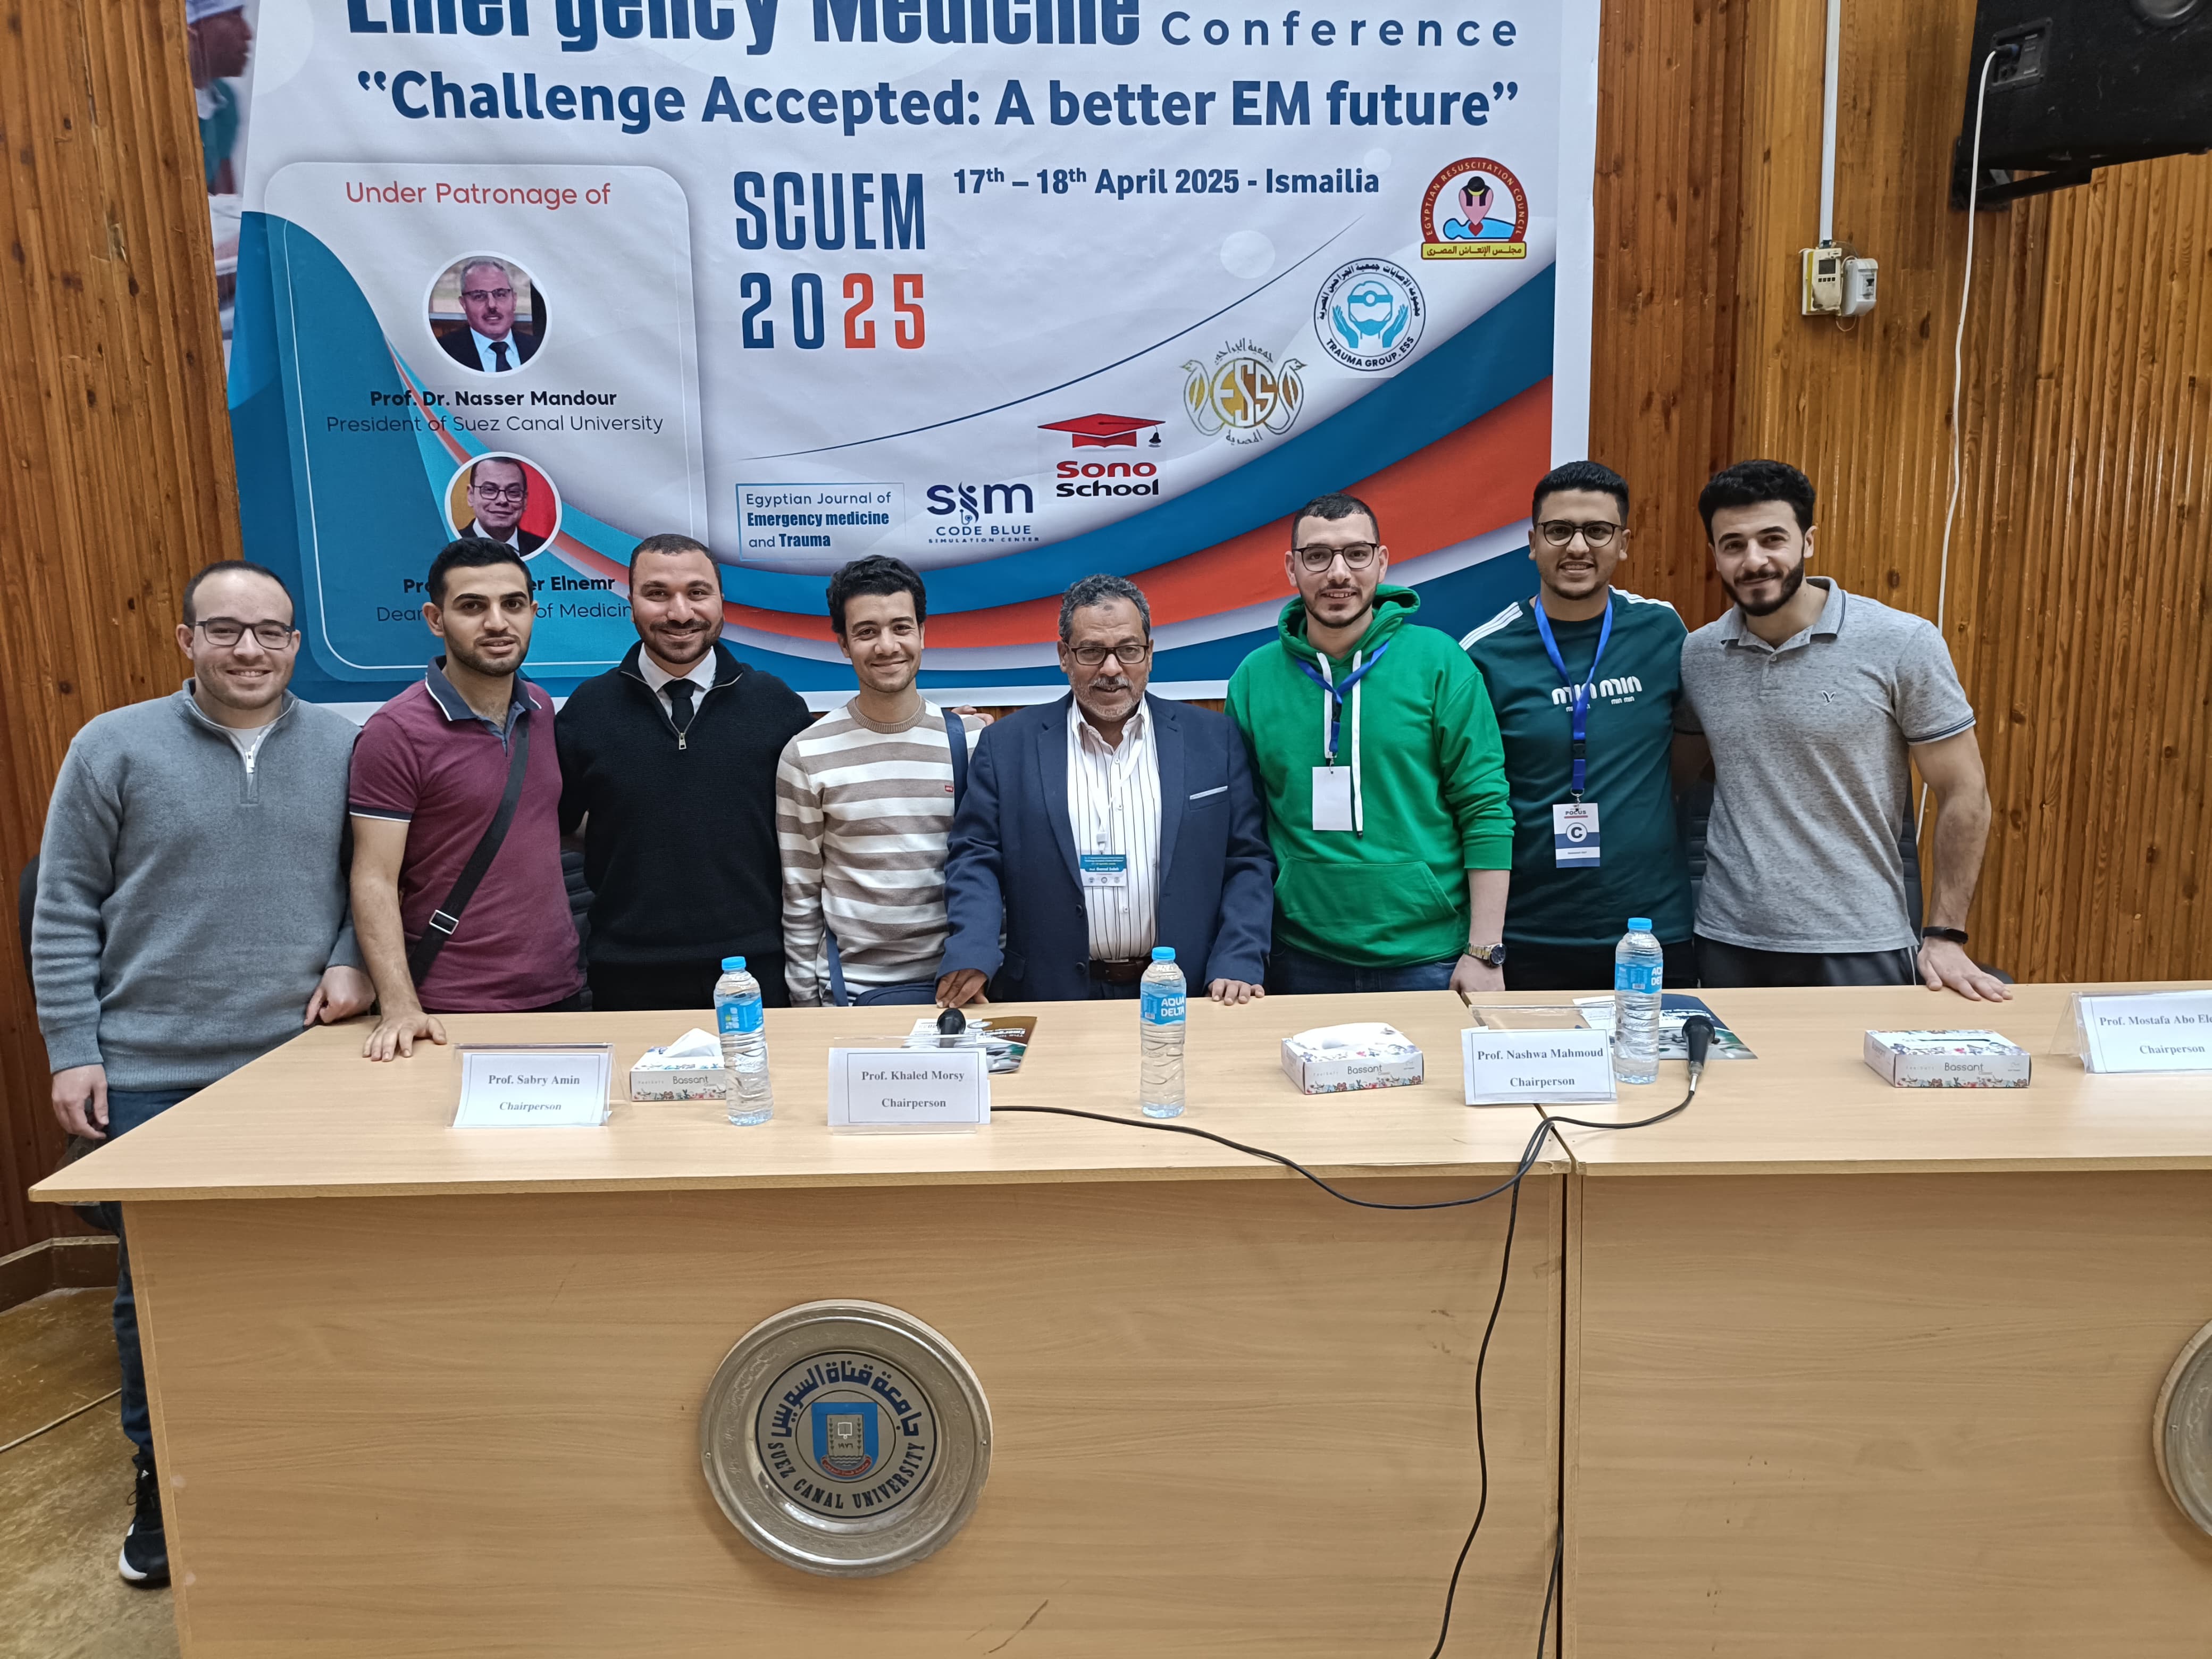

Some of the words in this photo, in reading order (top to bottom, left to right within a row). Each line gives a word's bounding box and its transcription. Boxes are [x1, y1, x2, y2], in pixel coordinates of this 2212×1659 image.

[1161, 11, 1517, 46] Conference
[701, 76, 980, 136] Accepted:
[994, 80, 1035, 125] A
[1049, 80, 1216, 125] better
[1233, 81, 1310, 125] EM
[953, 167, 1004, 194] 17th
[1036, 167, 1086, 194] 18th
[1095, 168, 1168, 200] April
[1175, 169, 1239, 194] 2025
[1266, 169, 1379, 194] Ismailia
[346, 181, 426, 203] Under
[435, 182, 577, 210] Patronage
[585, 182, 611, 205] of
[1424, 182, 1440, 236] EGYPTIAN
[1440, 162, 1514, 186] RESUSCITATION
[1513, 188, 1525, 234] COUNCIL
[734, 171, 926, 250] SCUEM
[1493, 246, 1522, 255] مجلس
[740, 272, 925, 349] 2025
[1326, 338, 1362, 366] TRAUMA
[1399, 337, 1414, 354] ESS
[370, 391, 417, 406] Prof.
[423, 391, 450, 406] Dr.
[455, 391, 524, 406] Nasser
[531, 391, 617, 406] Mandour
[326, 416, 422, 432] President
[428, 416, 447, 431] of
[453, 416, 500, 431] Suez
[506, 416, 564, 431] Canal
[571, 416, 664, 434] University
[1056, 460, 1157, 478] Sono
[1056, 479, 1159, 497] School
[746, 493, 812, 508] Egyptian
[817, 492, 872, 505] Journal
[877, 491, 891, 503] of
[747, 512, 823, 527] Emergency
[826, 511, 889, 525] medicine
[936, 526, 982, 535] CODE
[991, 525, 1032, 535] BLUE
[749, 535, 775, 548] and
[778, 533, 831, 547] Trauma
[551, 575, 615, 591] Elnemr
[536, 602, 554, 618] of
[560, 602, 632, 618] Medicin
[1571, 826, 1582, 839] C
[1651, 967, 1662, 976] AQ
[1161, 995, 1185, 1007] AQUA
[1161, 1006, 1185, 1017] DELTA
[2100, 1017, 2125, 1026] Prof.
[2129, 1016, 2171, 1025] Mostafa
[2174, 1015, 2195, 1024] Abo
[1477, 1051, 1503, 1060] Prof.
[1506, 1050, 1547, 1059] Nashwa
[1551, 1048, 1604, 1058] Mahmoud
[2139, 1045, 2206, 1055] Chairperson
[1347, 1064, 1382, 1075] Bassant
[1945, 1062, 1983, 1071] Bassant
[488, 1075, 514, 1084] Prof.
[517, 1075, 548, 1086] Sabry
[551, 1075, 580, 1084] Amin
[673, 1075, 709, 1084] Bassant
[861, 1071, 887, 1080] Prof.
[891, 1070, 928, 1080] Khaled
[932, 1070, 965, 1081] Morsy
[1510, 1077, 1575, 1088] Chairperson
[499, 1102, 562, 1112] Chairperson
[881, 1098, 946, 1109] Chairperson
[826, 1360, 873, 1386] قناة
[771, 1364, 826, 1437] السويس
[871, 1371, 922, 1436] جامعة
[768, 1442, 796, 1479] SUEZ
[793, 1478, 844, 1509] CANAL
[852, 1442, 925, 1509] UNIVERSITY
